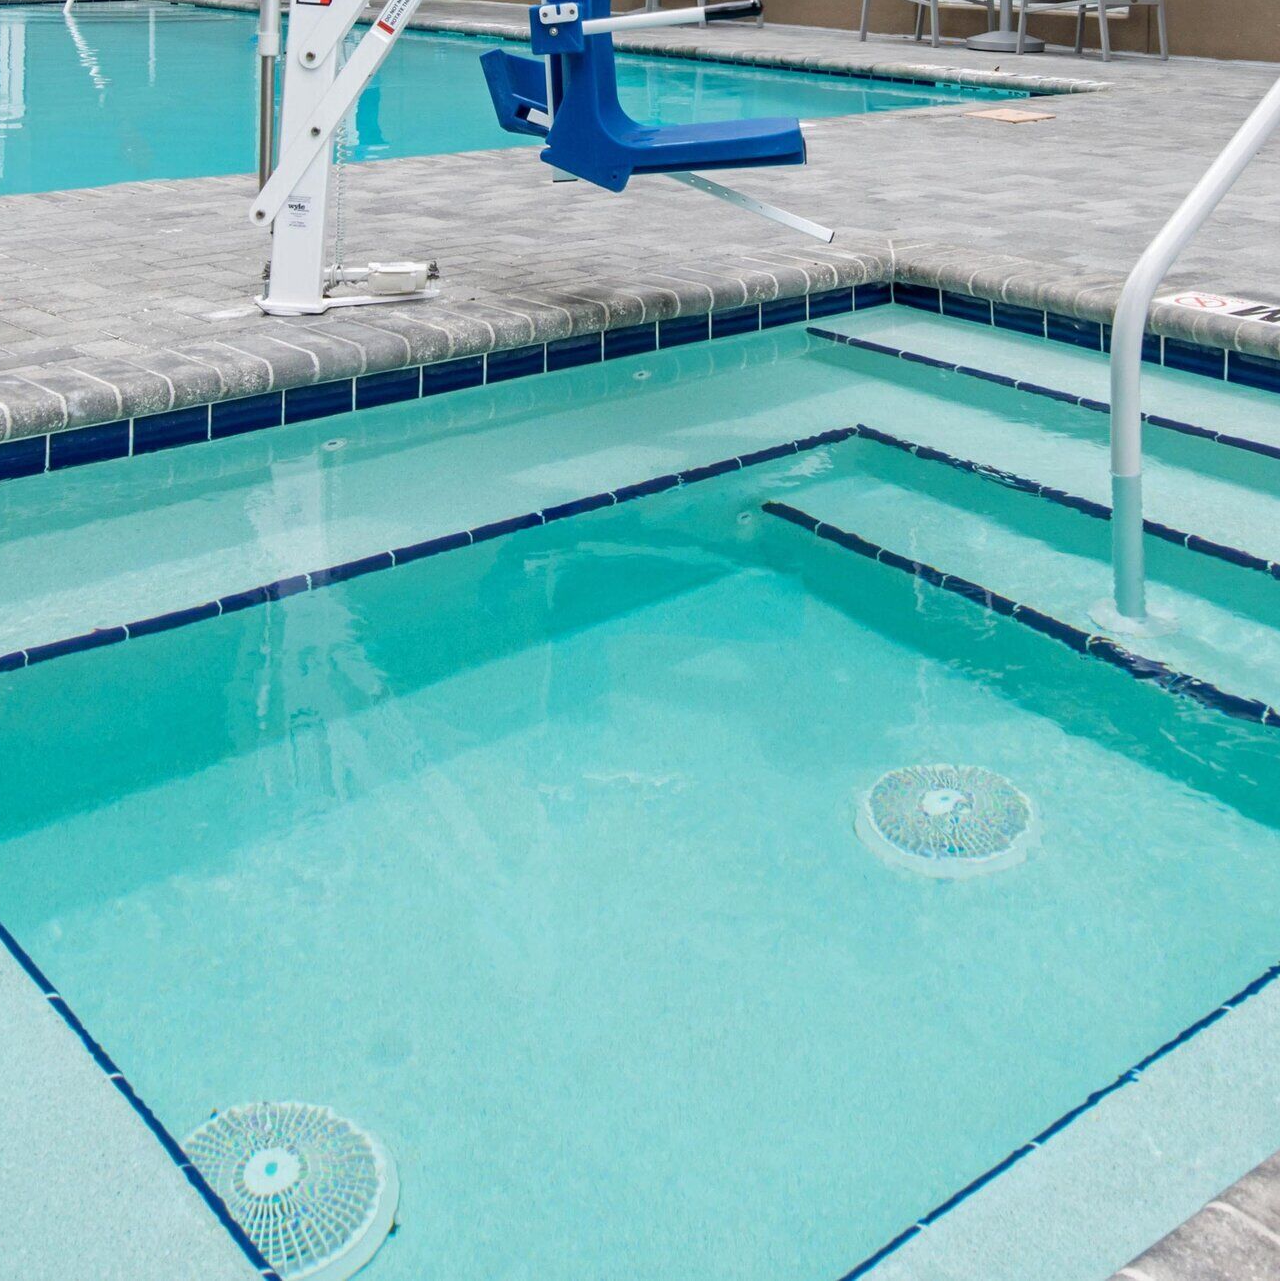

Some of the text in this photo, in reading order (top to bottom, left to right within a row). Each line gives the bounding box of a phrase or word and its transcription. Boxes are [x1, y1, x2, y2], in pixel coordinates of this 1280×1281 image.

[385, 14, 391, 22] DO
[390, 4, 398, 14] NOT
[391, 8, 404, 25] ROTATE
